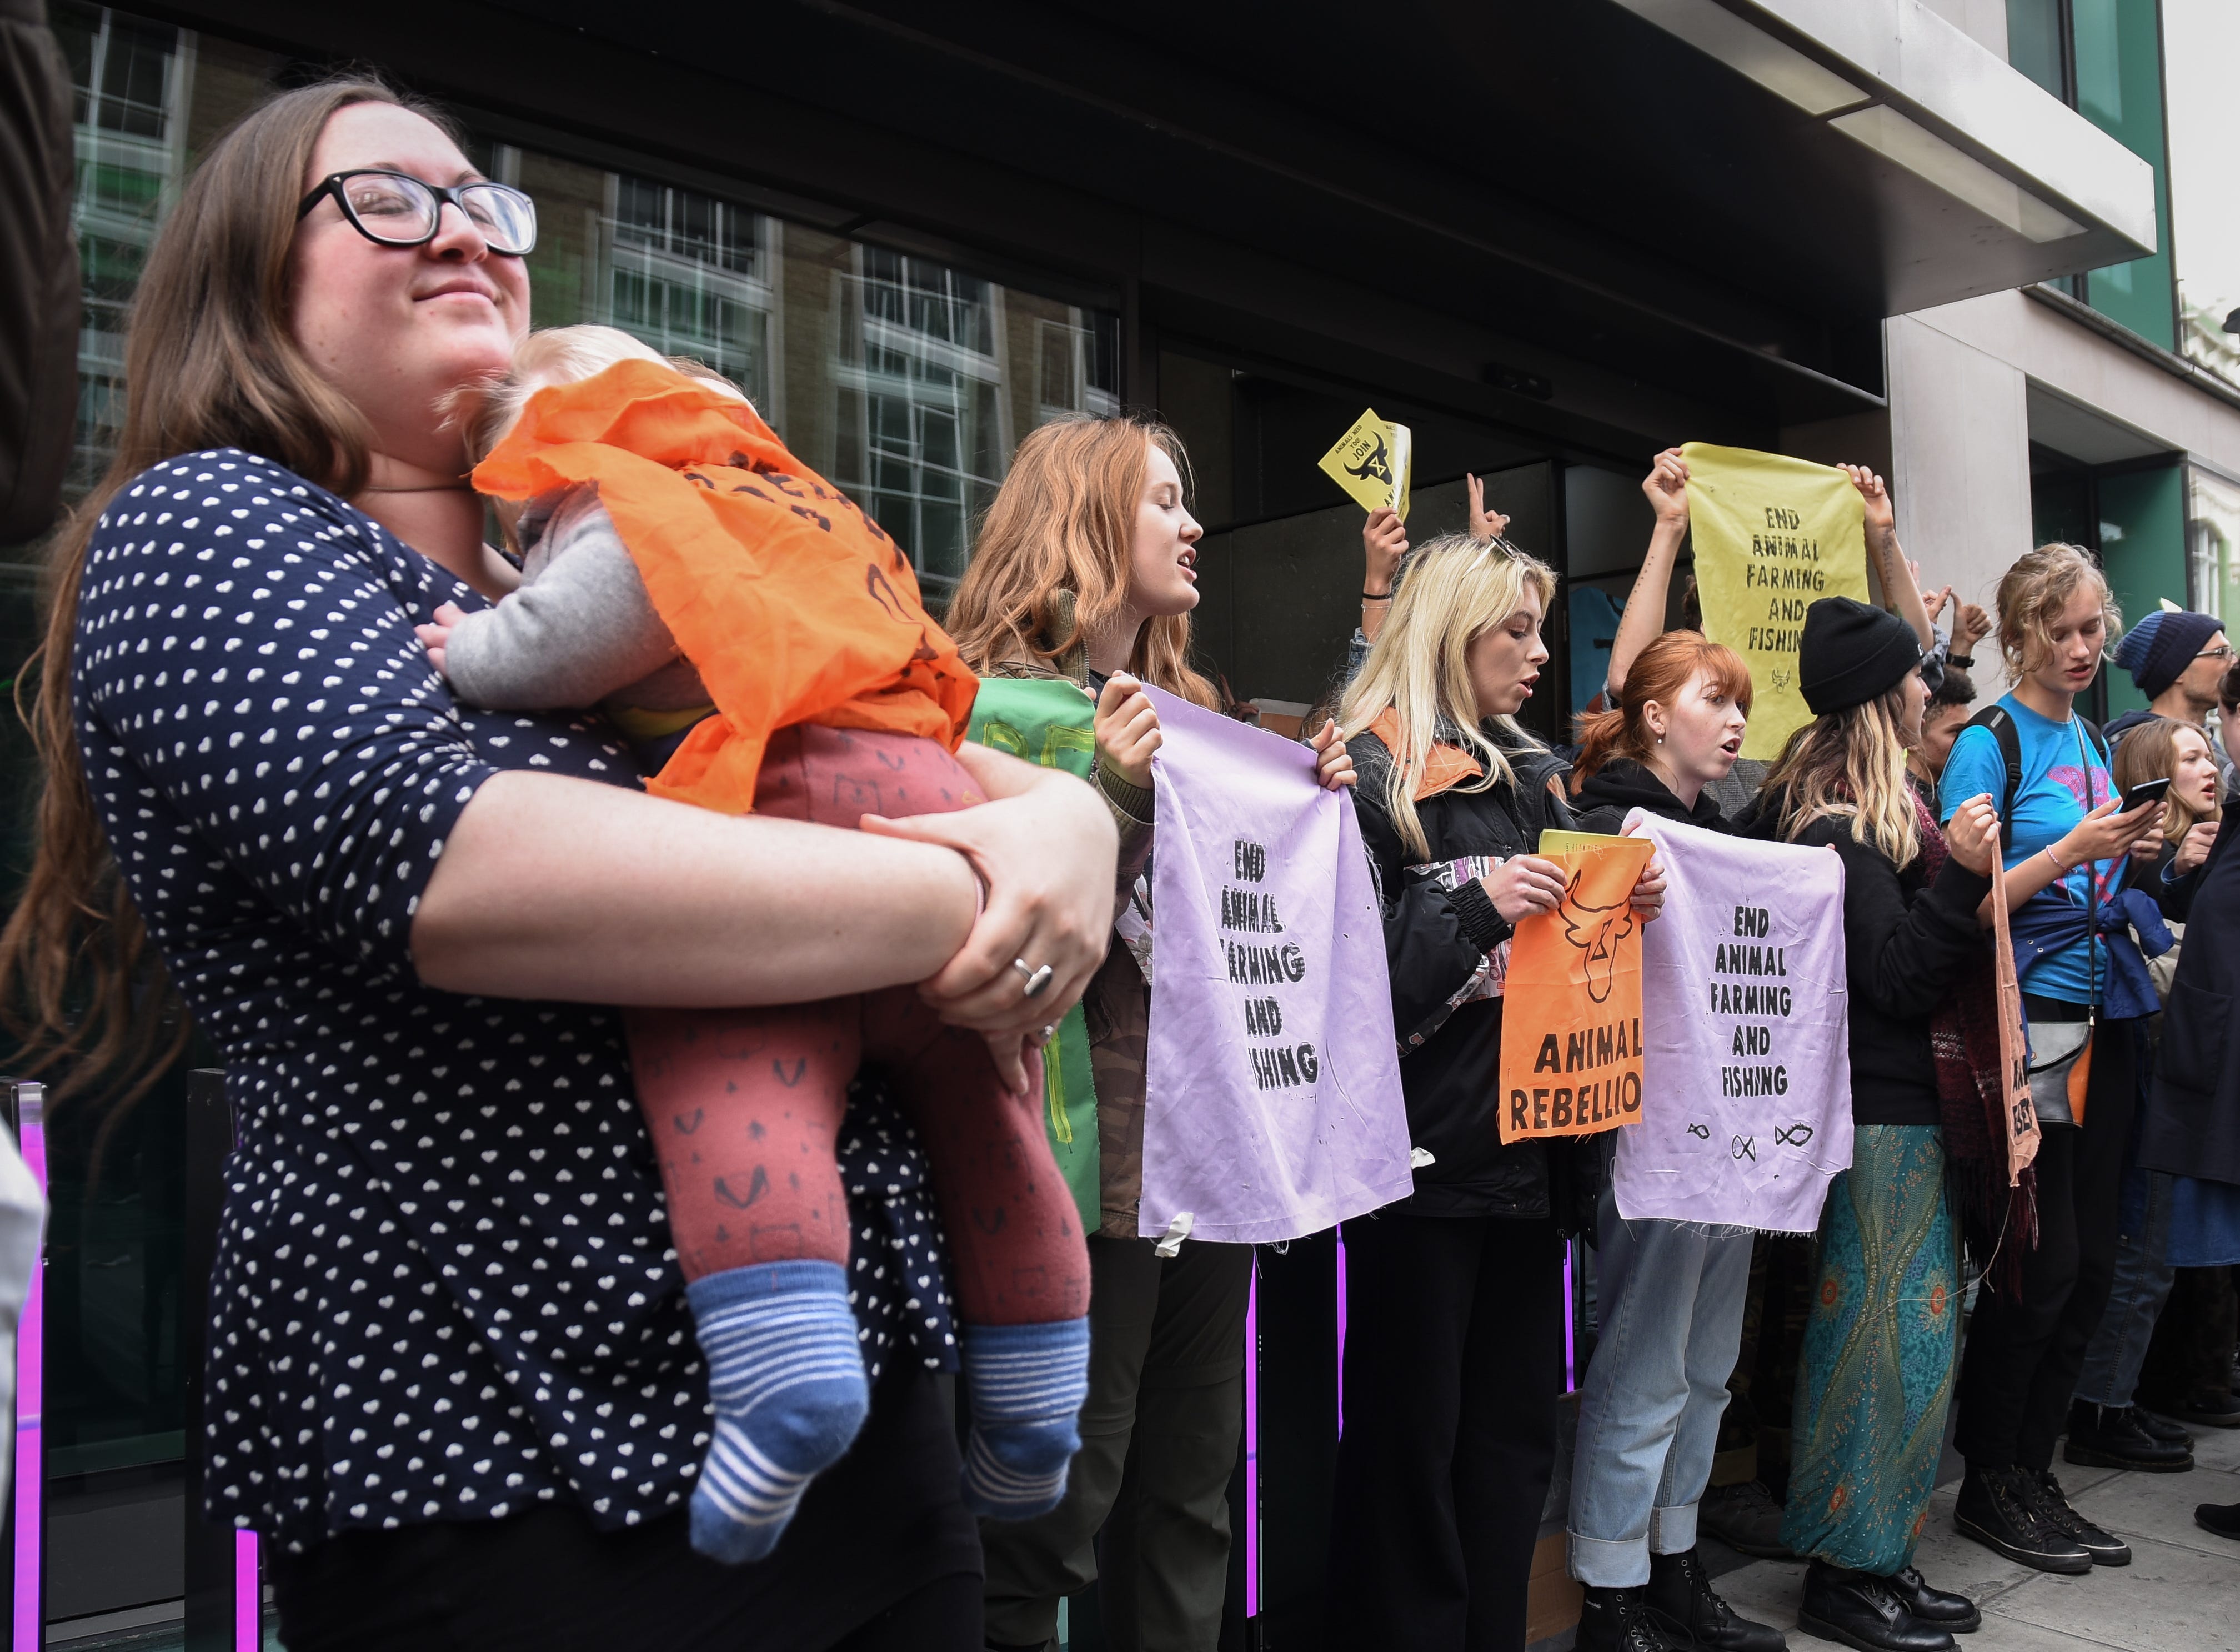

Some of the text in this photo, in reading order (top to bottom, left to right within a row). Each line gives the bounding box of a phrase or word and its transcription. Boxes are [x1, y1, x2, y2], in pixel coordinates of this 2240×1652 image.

[1335, 425, 1362, 454] ANIMALS NEED
[1353, 440, 1371, 460] JOIN
[1765, 506, 1800, 530] END
[1752, 534, 1820, 561] ANIMAL
[1747, 564, 1825, 592] FARMING
[1768, 599, 1805, 622] AND
[1748, 626, 1803, 652] FISHIN
[1234, 838, 1266, 883] END
[1221, 885, 1284, 933] ANIMAL
[1733, 905, 1770, 938] END
[1219, 939, 1306, 985] ARMING
[1715, 943, 1787, 976] ANIMAL
[1710, 982, 1792, 1017] FARMING
[1244, 996, 1282, 1038] AND
[1533, 1018, 1643, 1074] ANIMAL
[1732, 1025, 1770, 1056] AND
[1248, 1042, 1319, 1091] SHING
[1722, 1065, 1788, 1098] FISHING
[1510, 1072, 1642, 1132] REBELLIO
